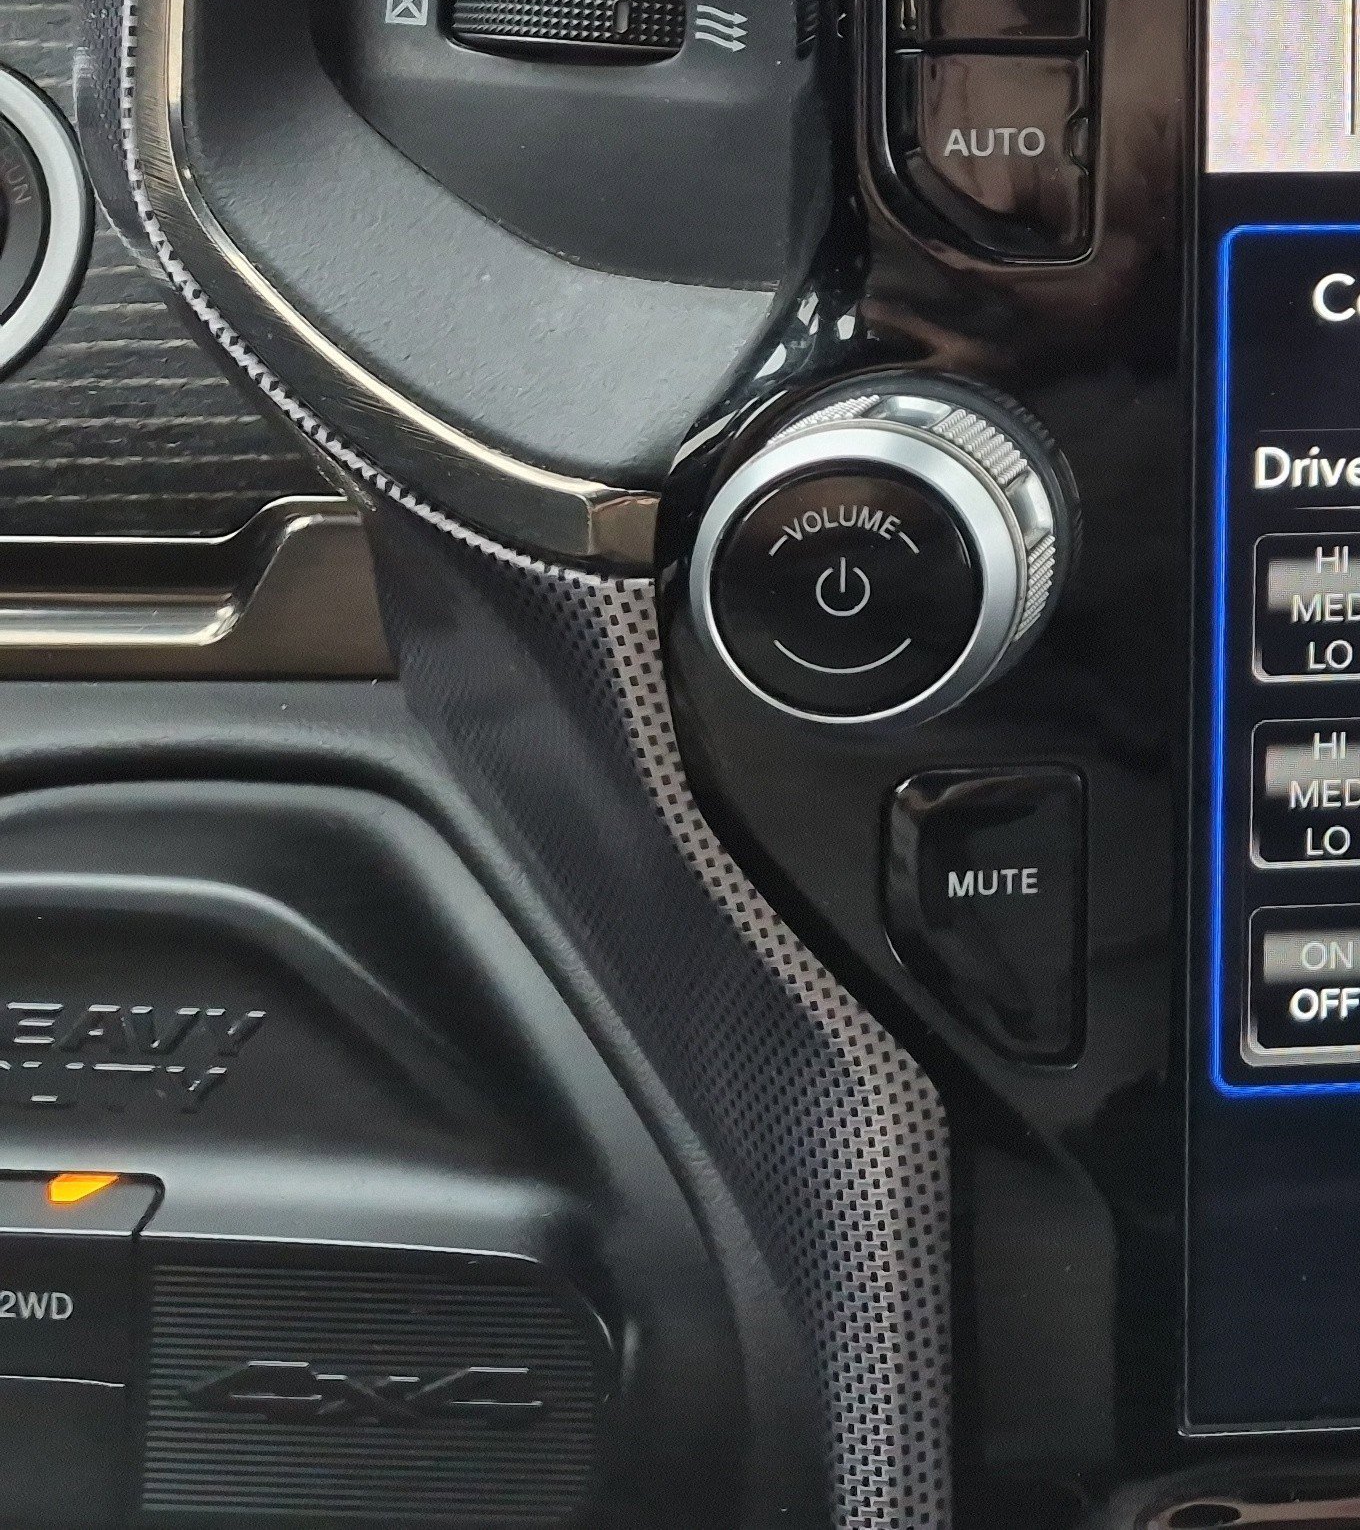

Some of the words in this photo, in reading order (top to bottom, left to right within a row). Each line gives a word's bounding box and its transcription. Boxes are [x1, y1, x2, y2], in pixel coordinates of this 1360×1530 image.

[943, 126, 1046, 157] AUTO
[782, 503, 901, 541] VOLUME
[1316, 545, 1350, 574] HI
[1307, 639, 1353, 670] LO
[1312, 730, 1347, 760] HI
[1306, 826, 1351, 857] LO
[947, 867, 1039, 898] MUTE
[1300, 940, 1354, 972] ON
[0, 1290, 74, 1320] 2WD
